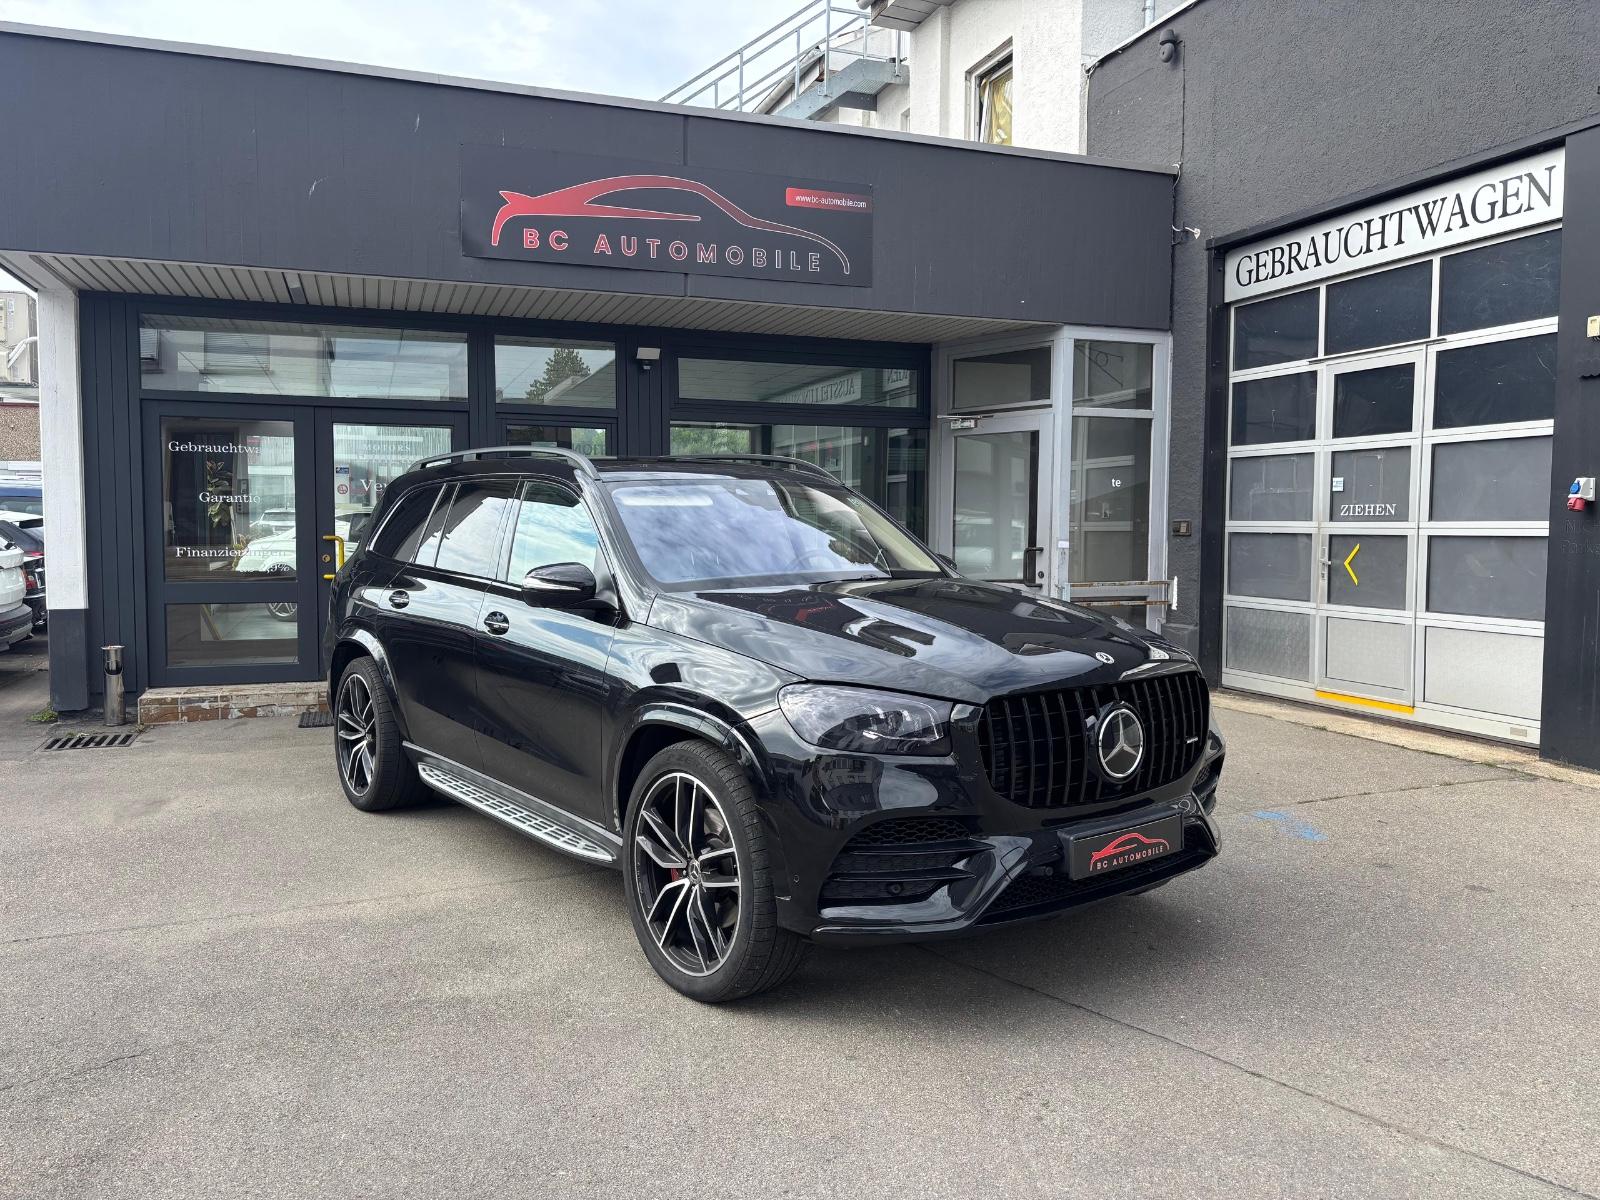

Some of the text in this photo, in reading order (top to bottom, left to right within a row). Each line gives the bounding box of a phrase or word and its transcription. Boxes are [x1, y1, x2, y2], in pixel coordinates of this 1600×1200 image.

[795, 194, 867, 208] www.bc-automobile.com
[1235, 164, 1557, 288] GEBRAUCHTWAGEN
[523, 228, 820, 272] BC AUTOMOBILE
[168, 440, 263, 455] Gebrauchtwa
[1340, 503, 1397, 516] ZIEHEN
[1112, 845, 1163, 866] AUTOMOBILE
